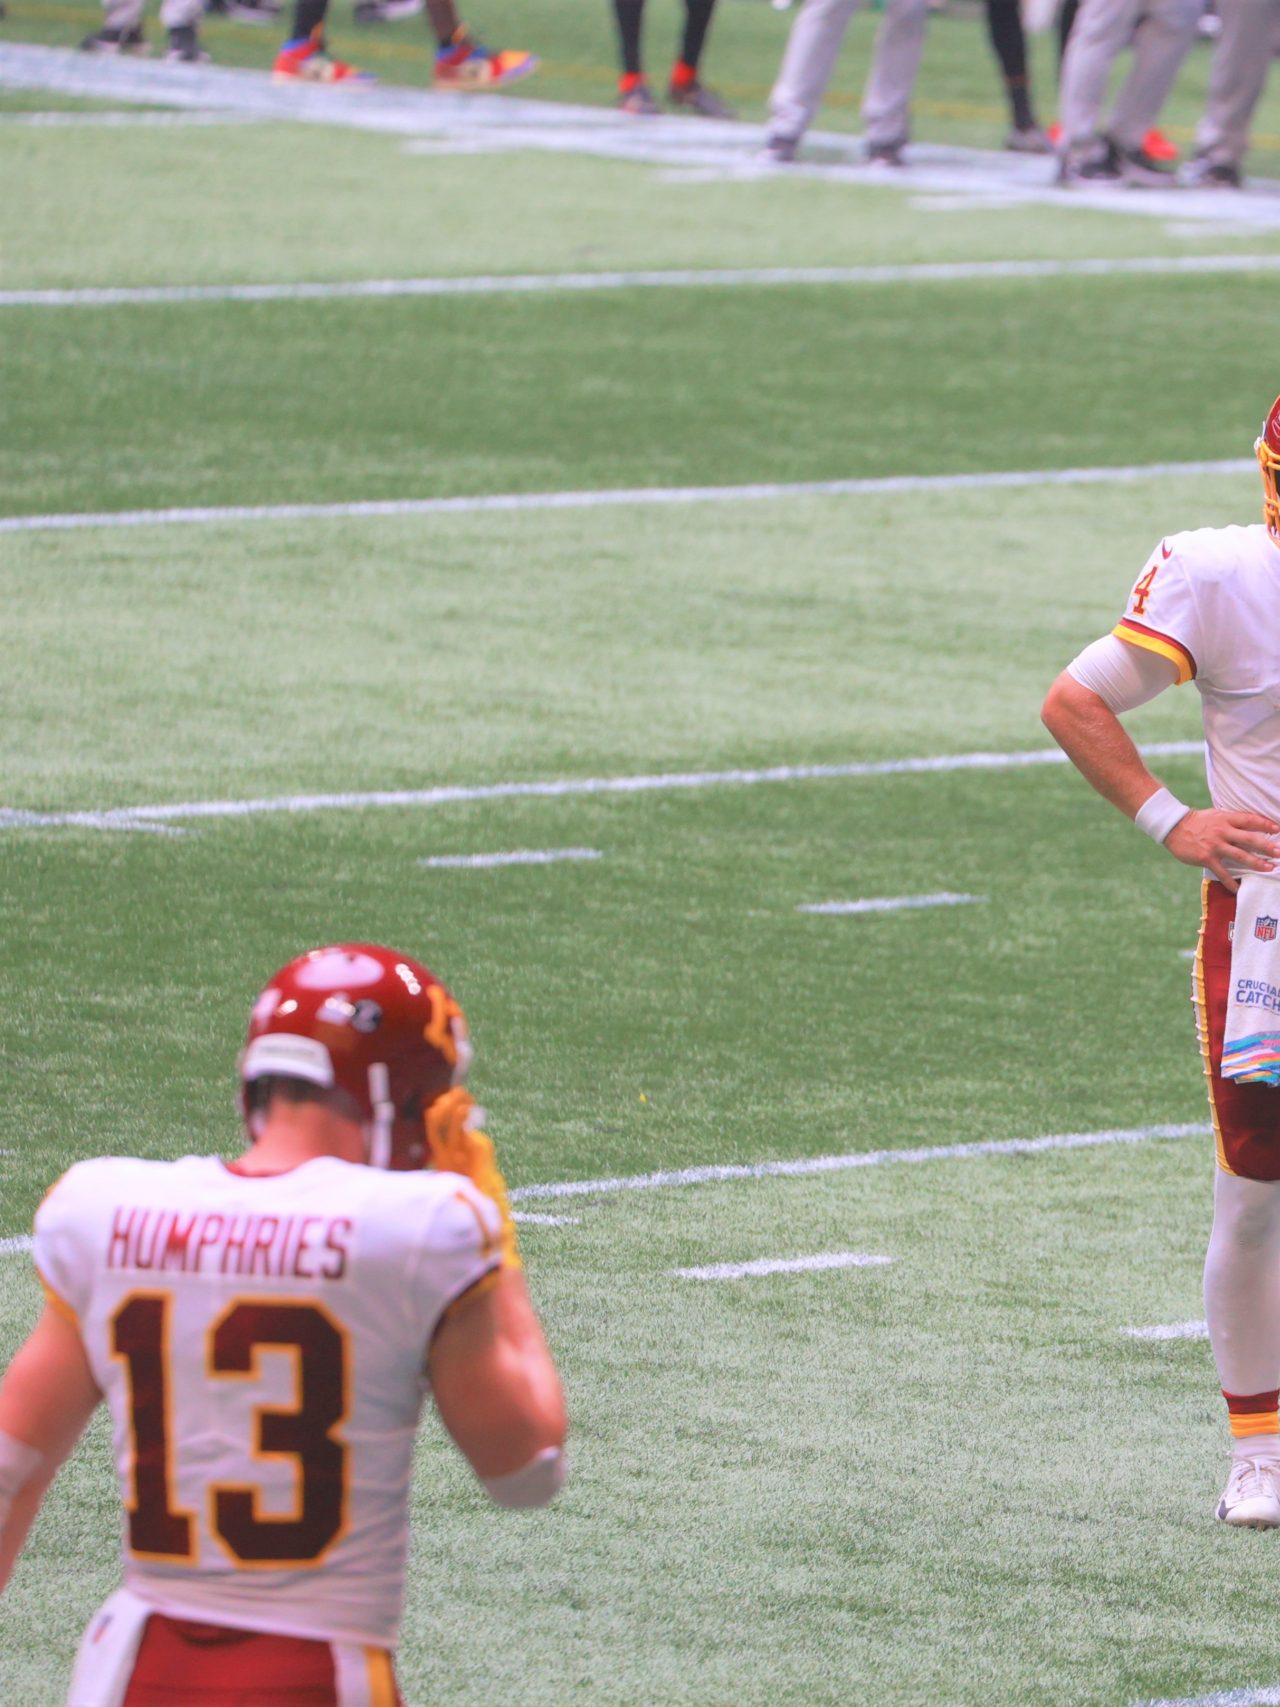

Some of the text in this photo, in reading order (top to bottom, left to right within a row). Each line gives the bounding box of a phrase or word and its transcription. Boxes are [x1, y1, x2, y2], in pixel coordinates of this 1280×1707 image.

[1132, 565, 1159, 615] 4
[107, 1206, 353, 1280] HUMPHRIES
[108, 1287, 353, 1570] 13
